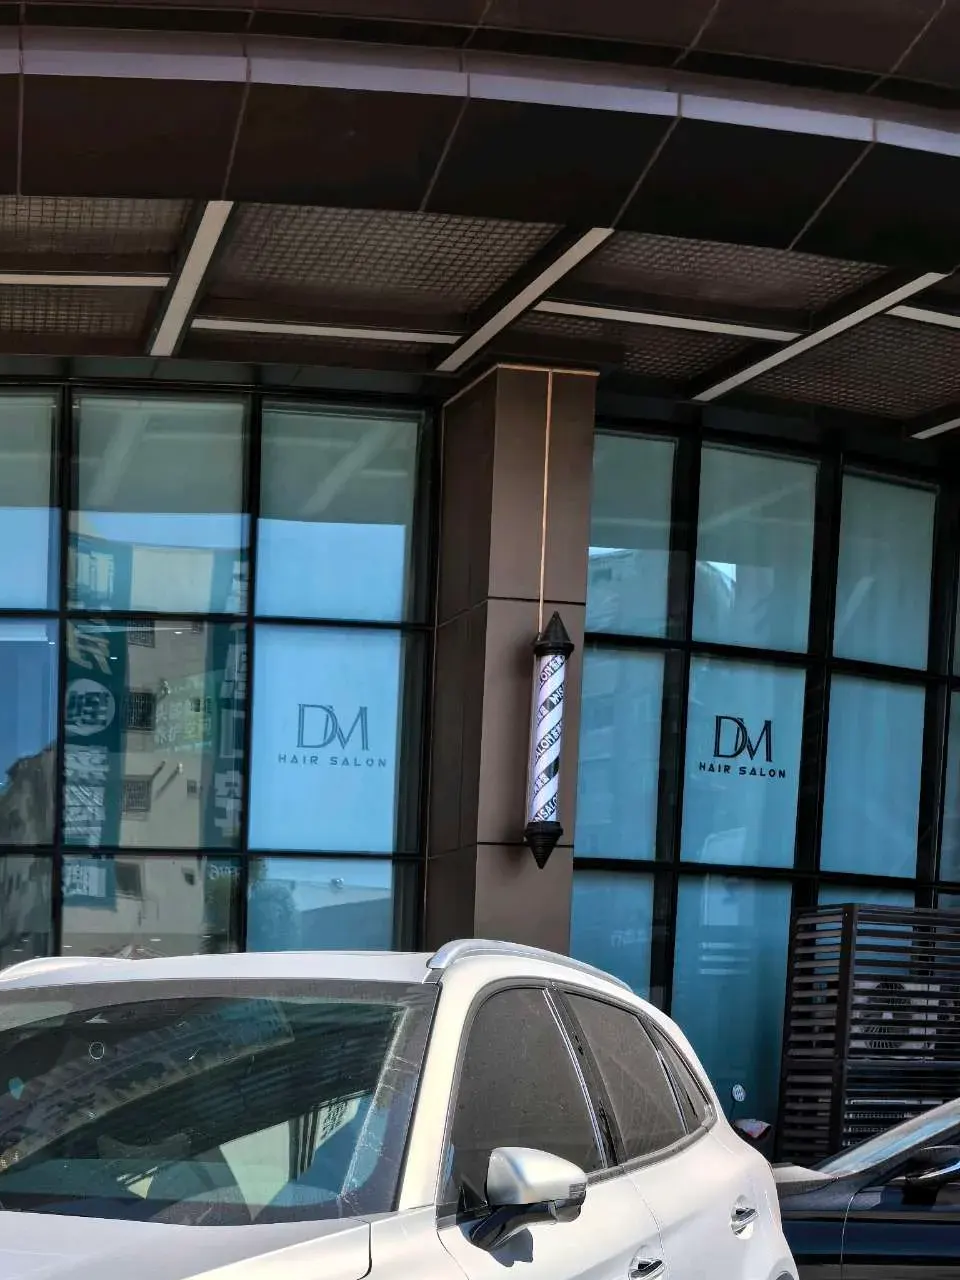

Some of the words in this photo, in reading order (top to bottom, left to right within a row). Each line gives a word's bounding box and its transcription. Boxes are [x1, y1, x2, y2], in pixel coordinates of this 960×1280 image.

[296, 703, 370, 751] DM
[713, 715, 772, 762] DM
[278, 753, 319, 765] HAIR
[330, 756, 386, 767] SALON
[699, 762, 731, 774] HAIR
[739, 766, 786, 778] SALON
